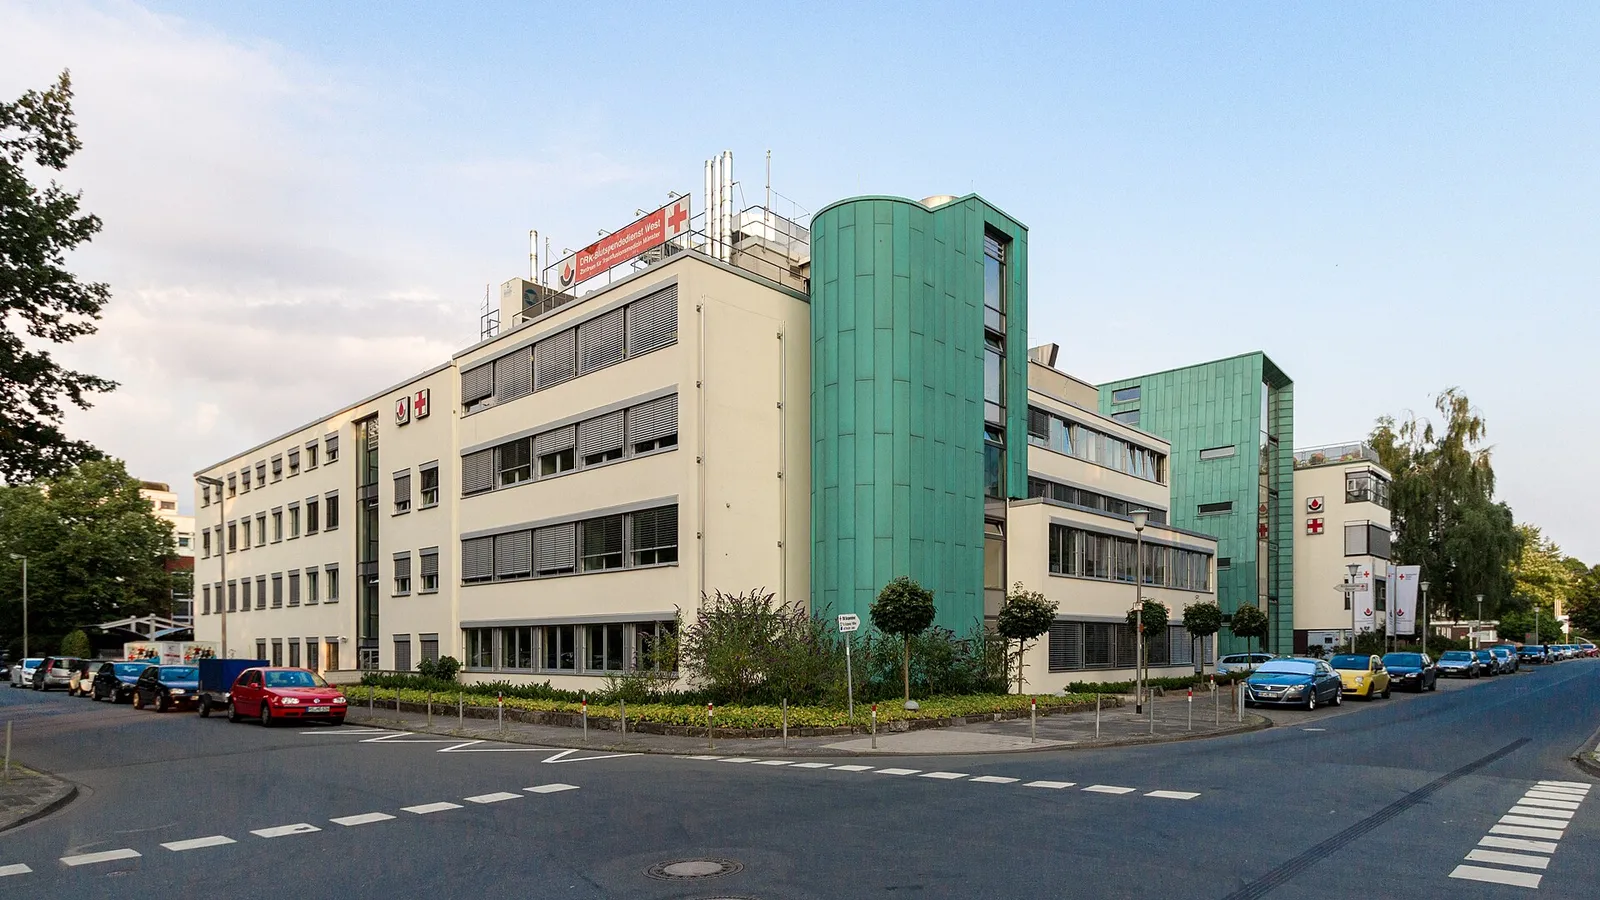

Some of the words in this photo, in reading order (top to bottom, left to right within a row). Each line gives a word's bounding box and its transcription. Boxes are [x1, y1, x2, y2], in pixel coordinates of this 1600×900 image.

[580, 228, 644, 266] DRK-Blutspendedienst
[645, 219, 661, 233] West
[580, 264, 596, 275] Zentrum
[602, 240, 642, 263] Transfusionsmedizin
[642, 231, 661, 244] Münster
